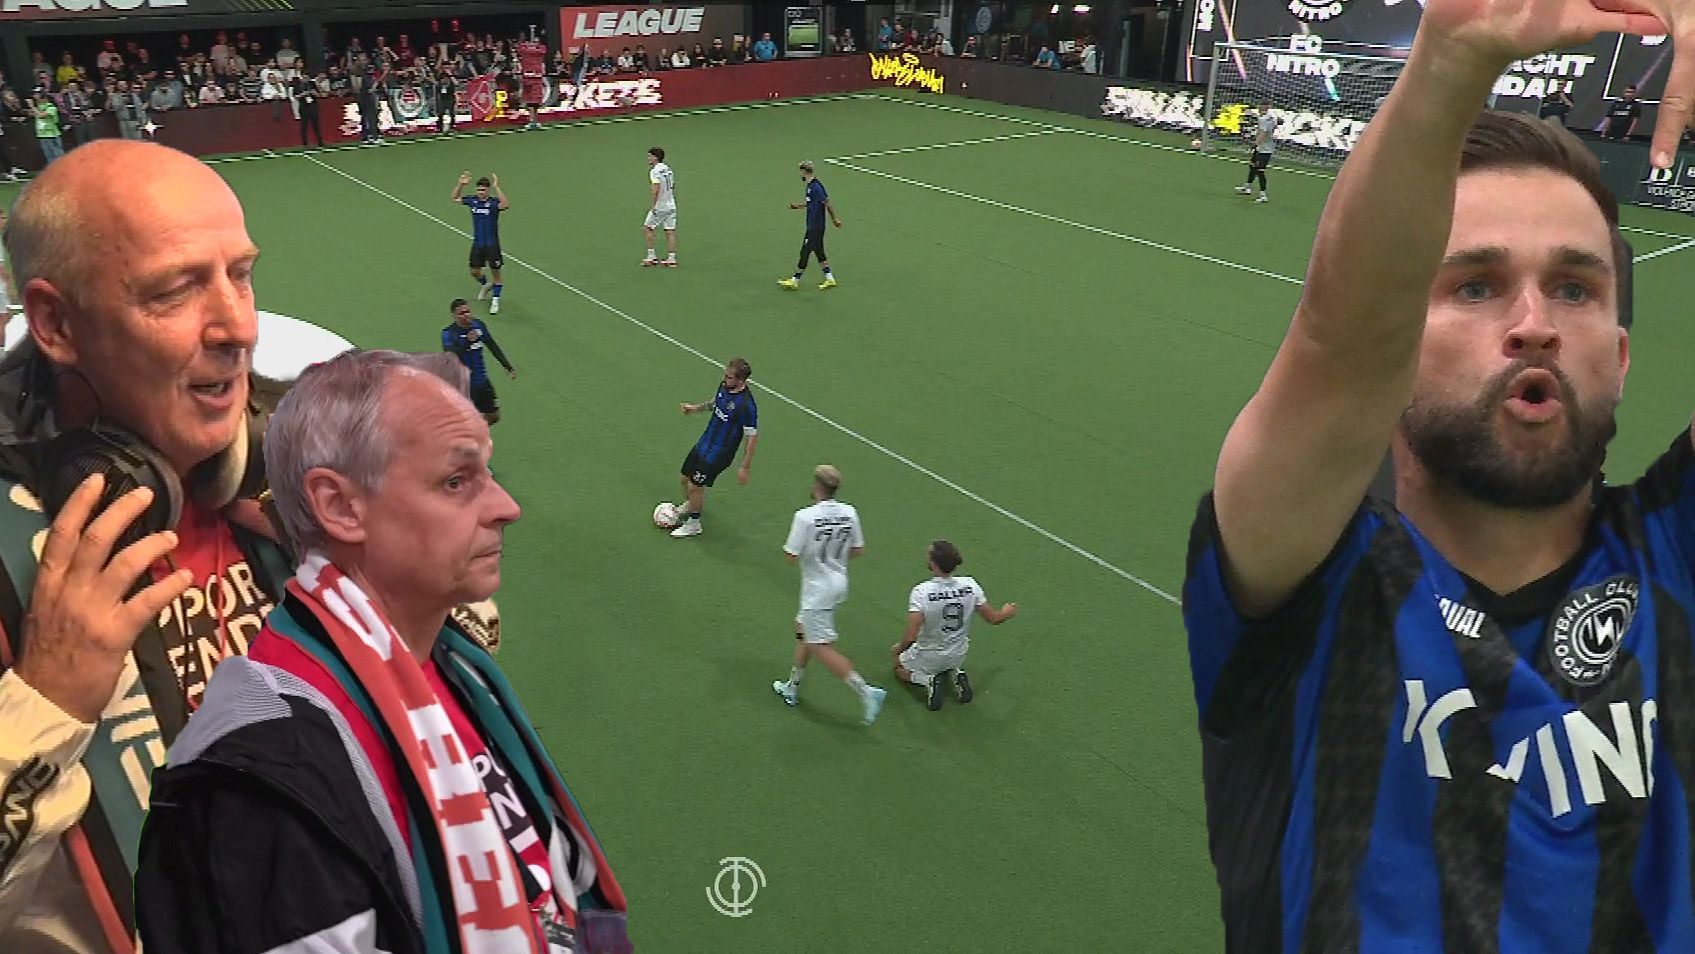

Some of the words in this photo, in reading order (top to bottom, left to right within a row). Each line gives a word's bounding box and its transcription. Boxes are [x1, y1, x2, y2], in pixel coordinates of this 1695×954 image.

[573, 7, 705, 38] LEAGUE
[1288, 1, 1343, 20] NITRO
[1266, 54, 1341, 77] NITRO
[941, 602, 964, 634] 9
[1554, 593, 1599, 679] FOOTBALL
